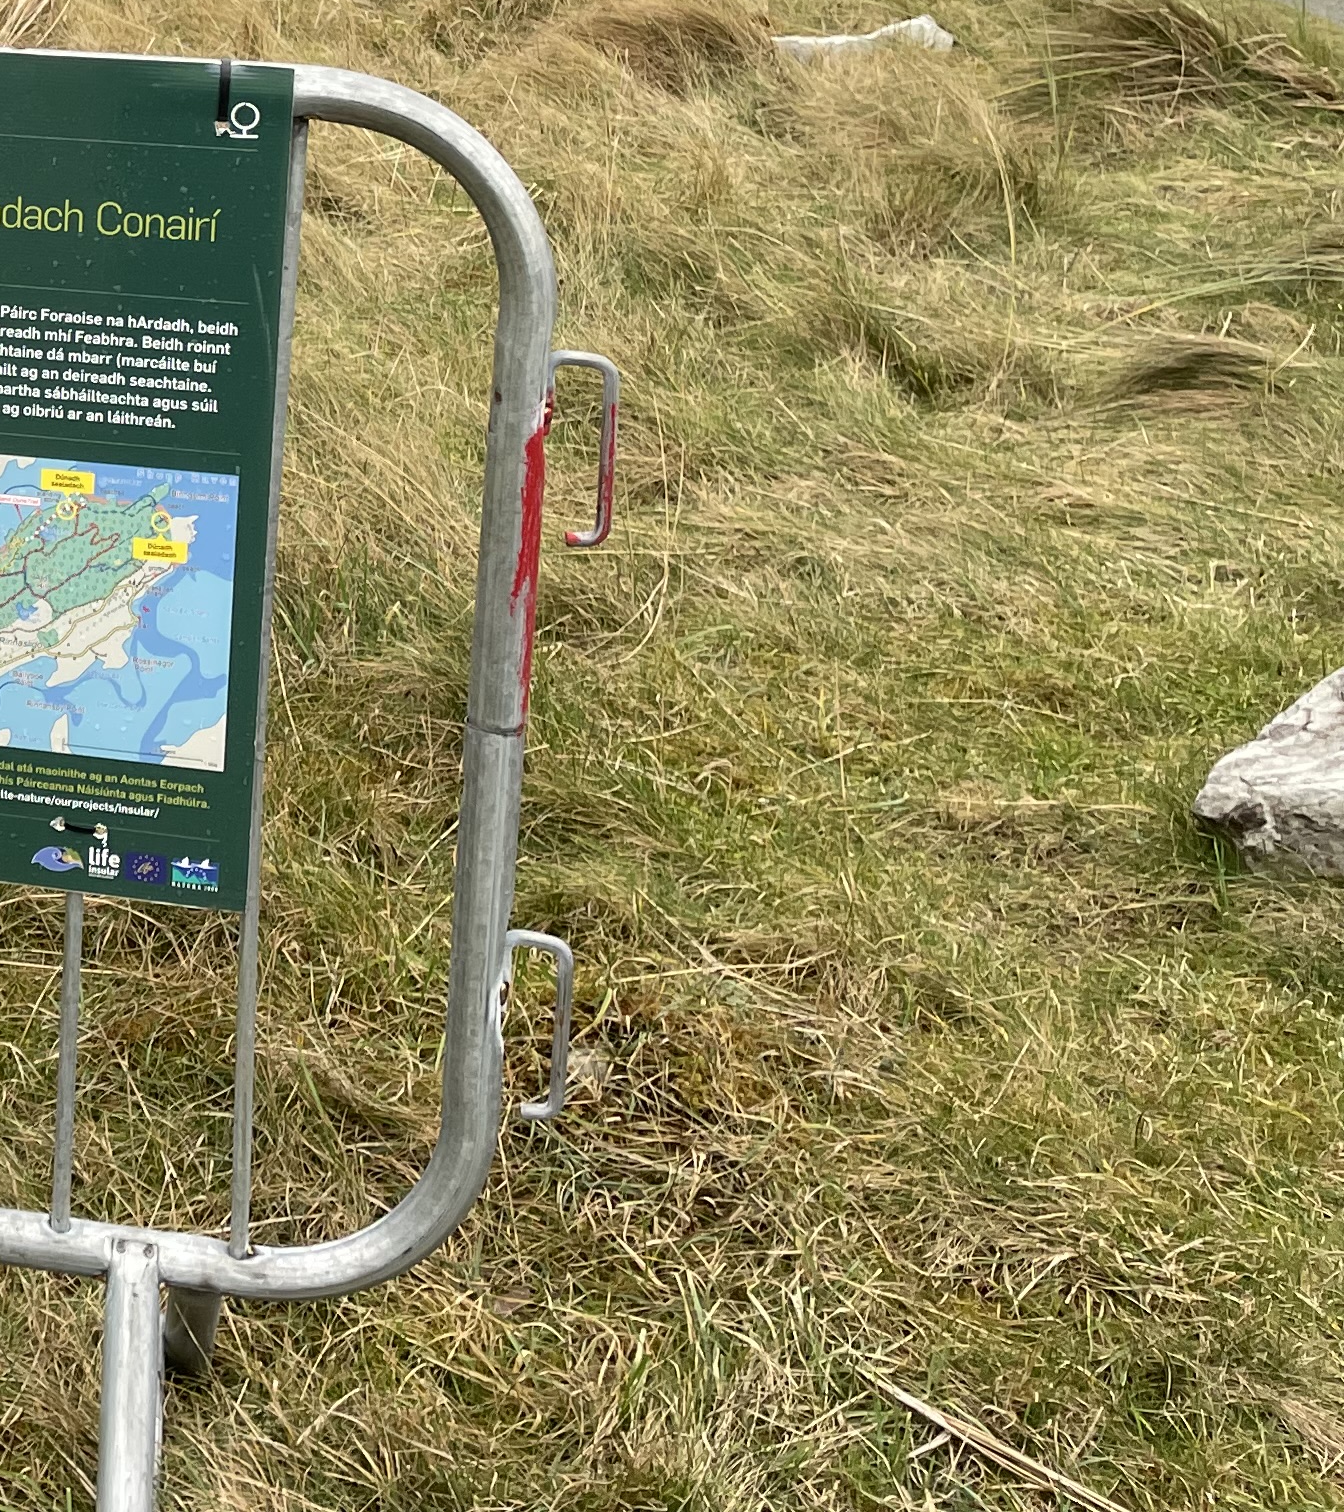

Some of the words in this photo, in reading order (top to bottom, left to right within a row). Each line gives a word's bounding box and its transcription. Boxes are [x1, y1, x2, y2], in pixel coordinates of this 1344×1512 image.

[97, 201, 221, 243] Conairí
[0, 304, 37, 319] Páirc
[40, 307, 103, 324] Foraoise
[105, 316, 124, 326] na
[127, 313, 194, 336] hArdadh,
[197, 318, 238, 334] beidh
[43, 328, 72, 342] mhí
[74, 329, 138, 347] Feabhra.
[141, 334, 183, 350] Beidh
[186, 339, 231, 353] roinnt
[88, 846, 120, 868] life
